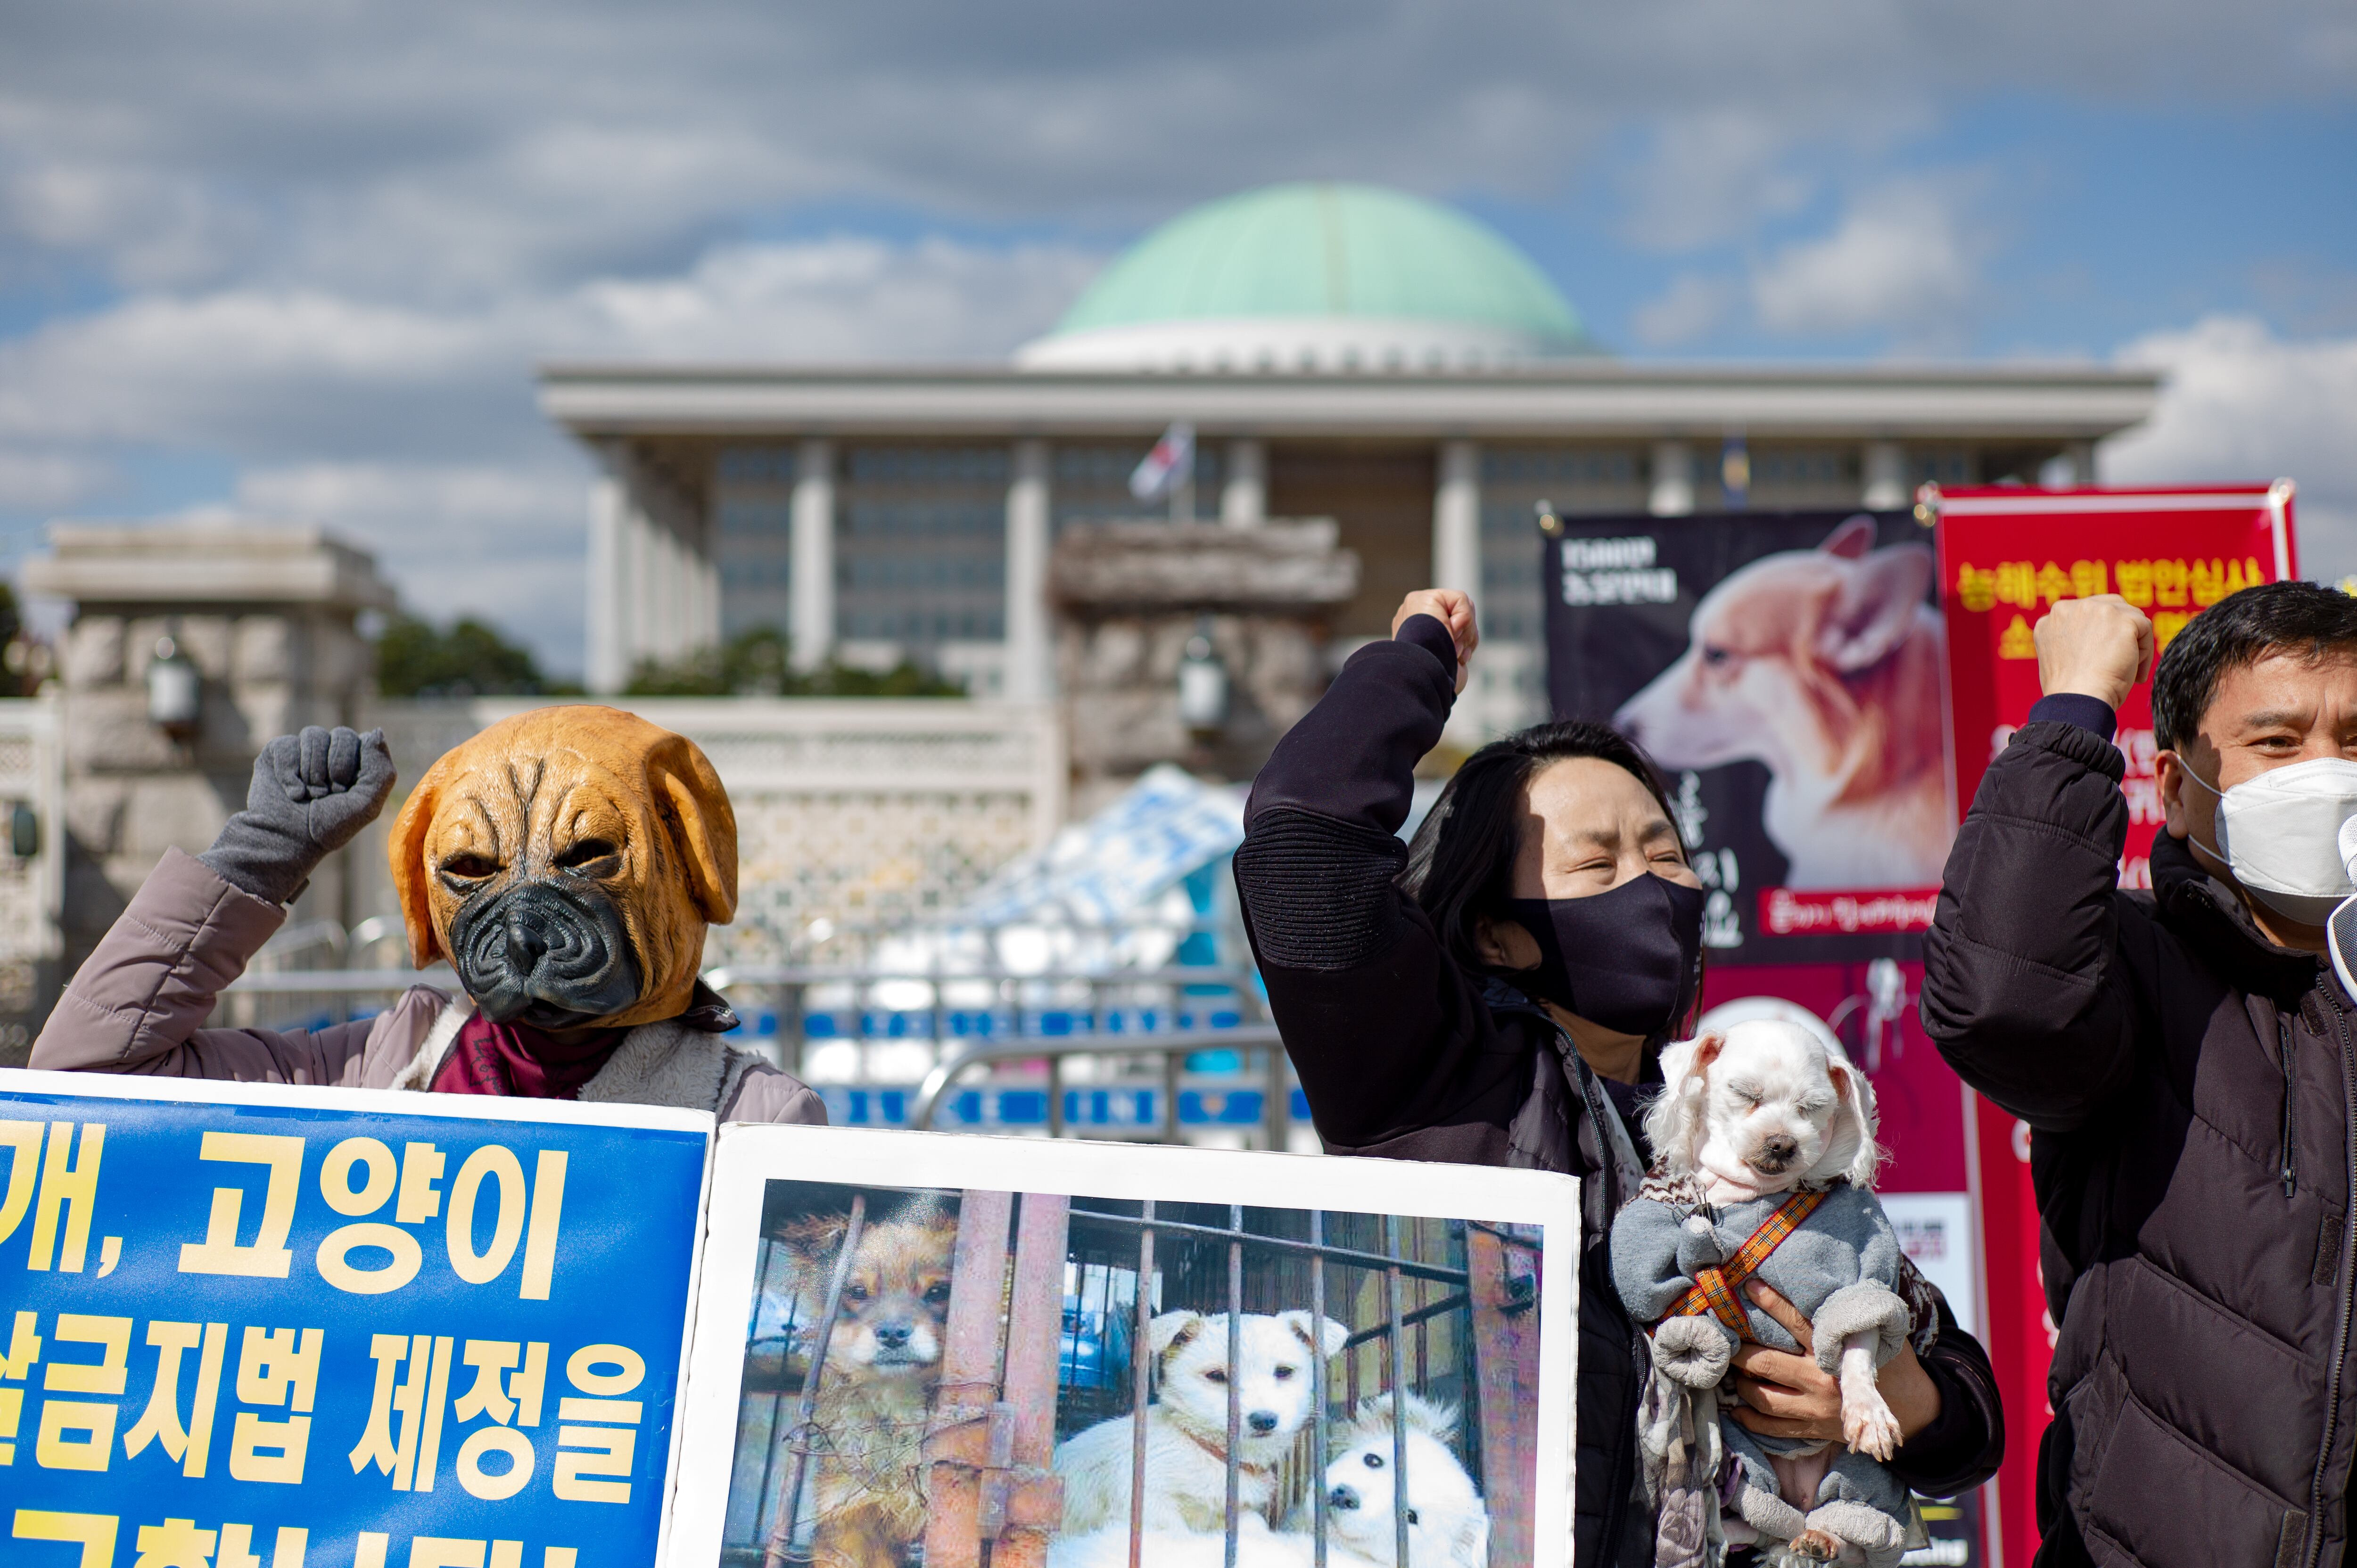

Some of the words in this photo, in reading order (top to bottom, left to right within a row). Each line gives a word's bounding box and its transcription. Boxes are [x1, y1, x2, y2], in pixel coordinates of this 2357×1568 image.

[0, 1120, 123, 1279] 개,
[178, 1131, 568, 1300] 고양이
[349, 1334, 646, 1503] 제정을
